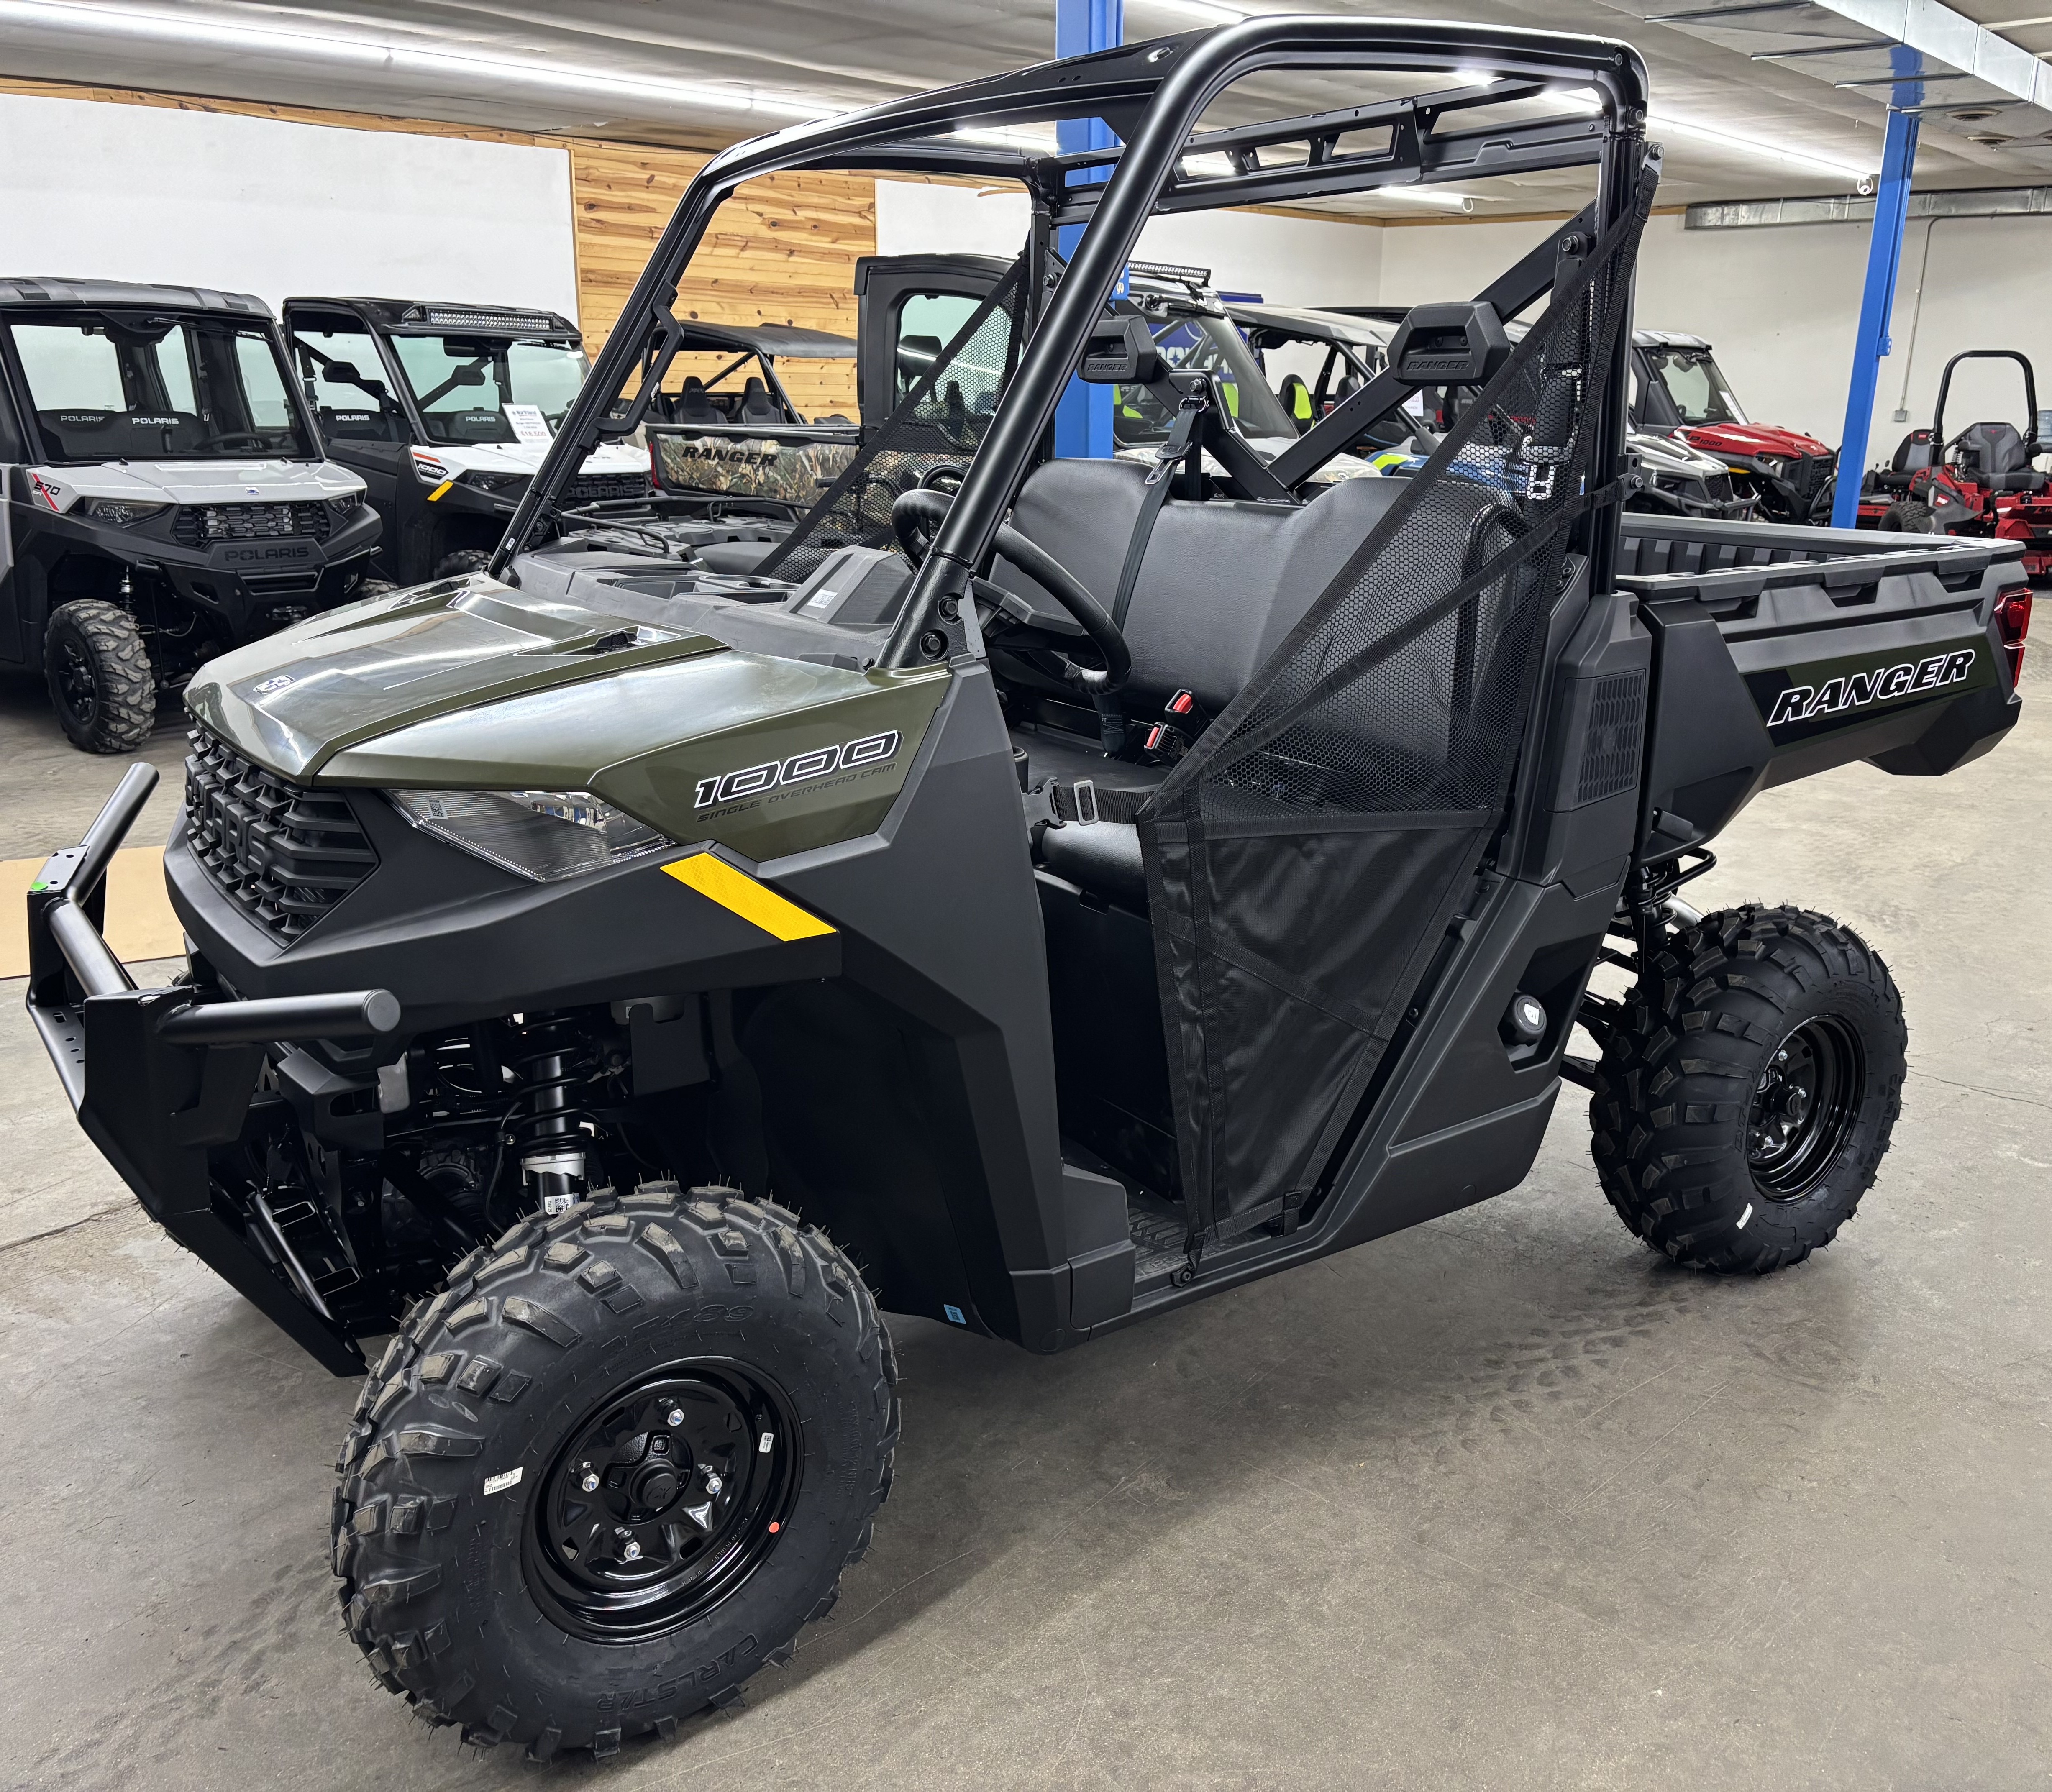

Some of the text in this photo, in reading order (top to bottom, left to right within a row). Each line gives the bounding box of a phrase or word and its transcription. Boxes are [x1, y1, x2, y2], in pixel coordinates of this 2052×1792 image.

[1087, 363, 1127, 372] RANGER
[1407, 361, 1470, 371] RANGER
[681, 446, 778, 466] RANGER
[418, 463, 447, 476] 1000
[34, 481, 61, 496] 570
[224, 546, 310, 561] POLARIS
[1766, 648, 1976, 727] RANGER
[694, 729, 904, 810] 1000
[697, 762, 897, 823] SINGLE OVERHEAD CAM
[597, 1633, 759, 1713] CARLSTAR
